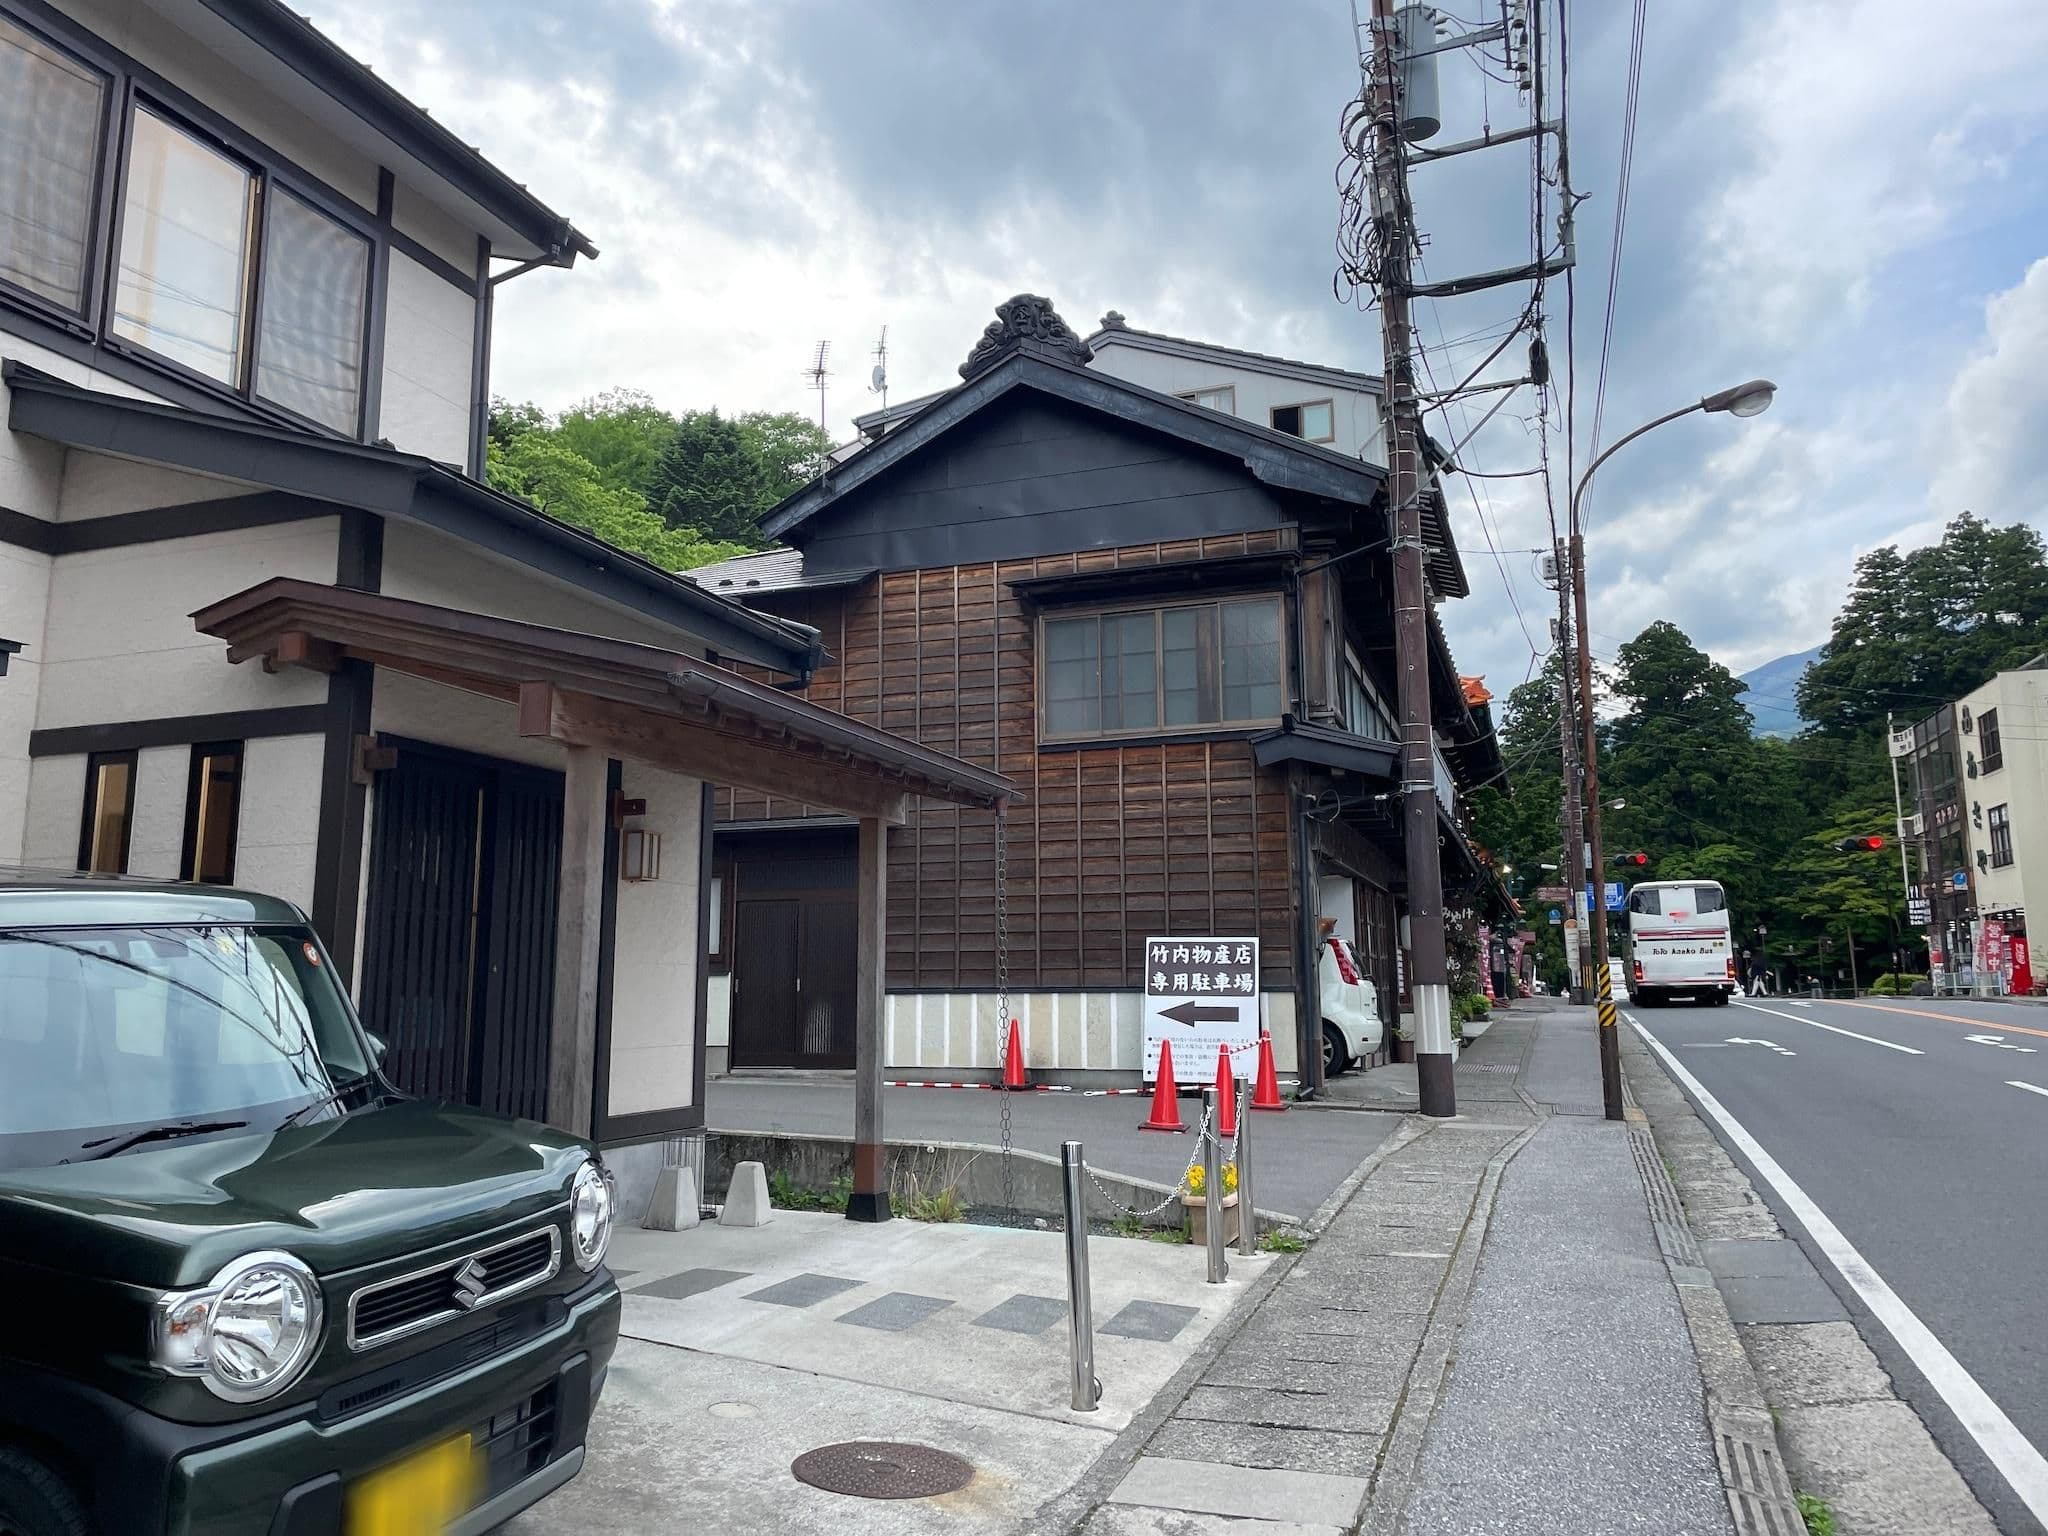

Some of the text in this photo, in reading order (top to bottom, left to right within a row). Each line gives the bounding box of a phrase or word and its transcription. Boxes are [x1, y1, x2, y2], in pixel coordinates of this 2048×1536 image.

[1150, 944, 1251, 964] 竹内物産店
[1699, 947, 1713, 955] Bus
[1150, 971, 1254, 992] 専用駐車場
